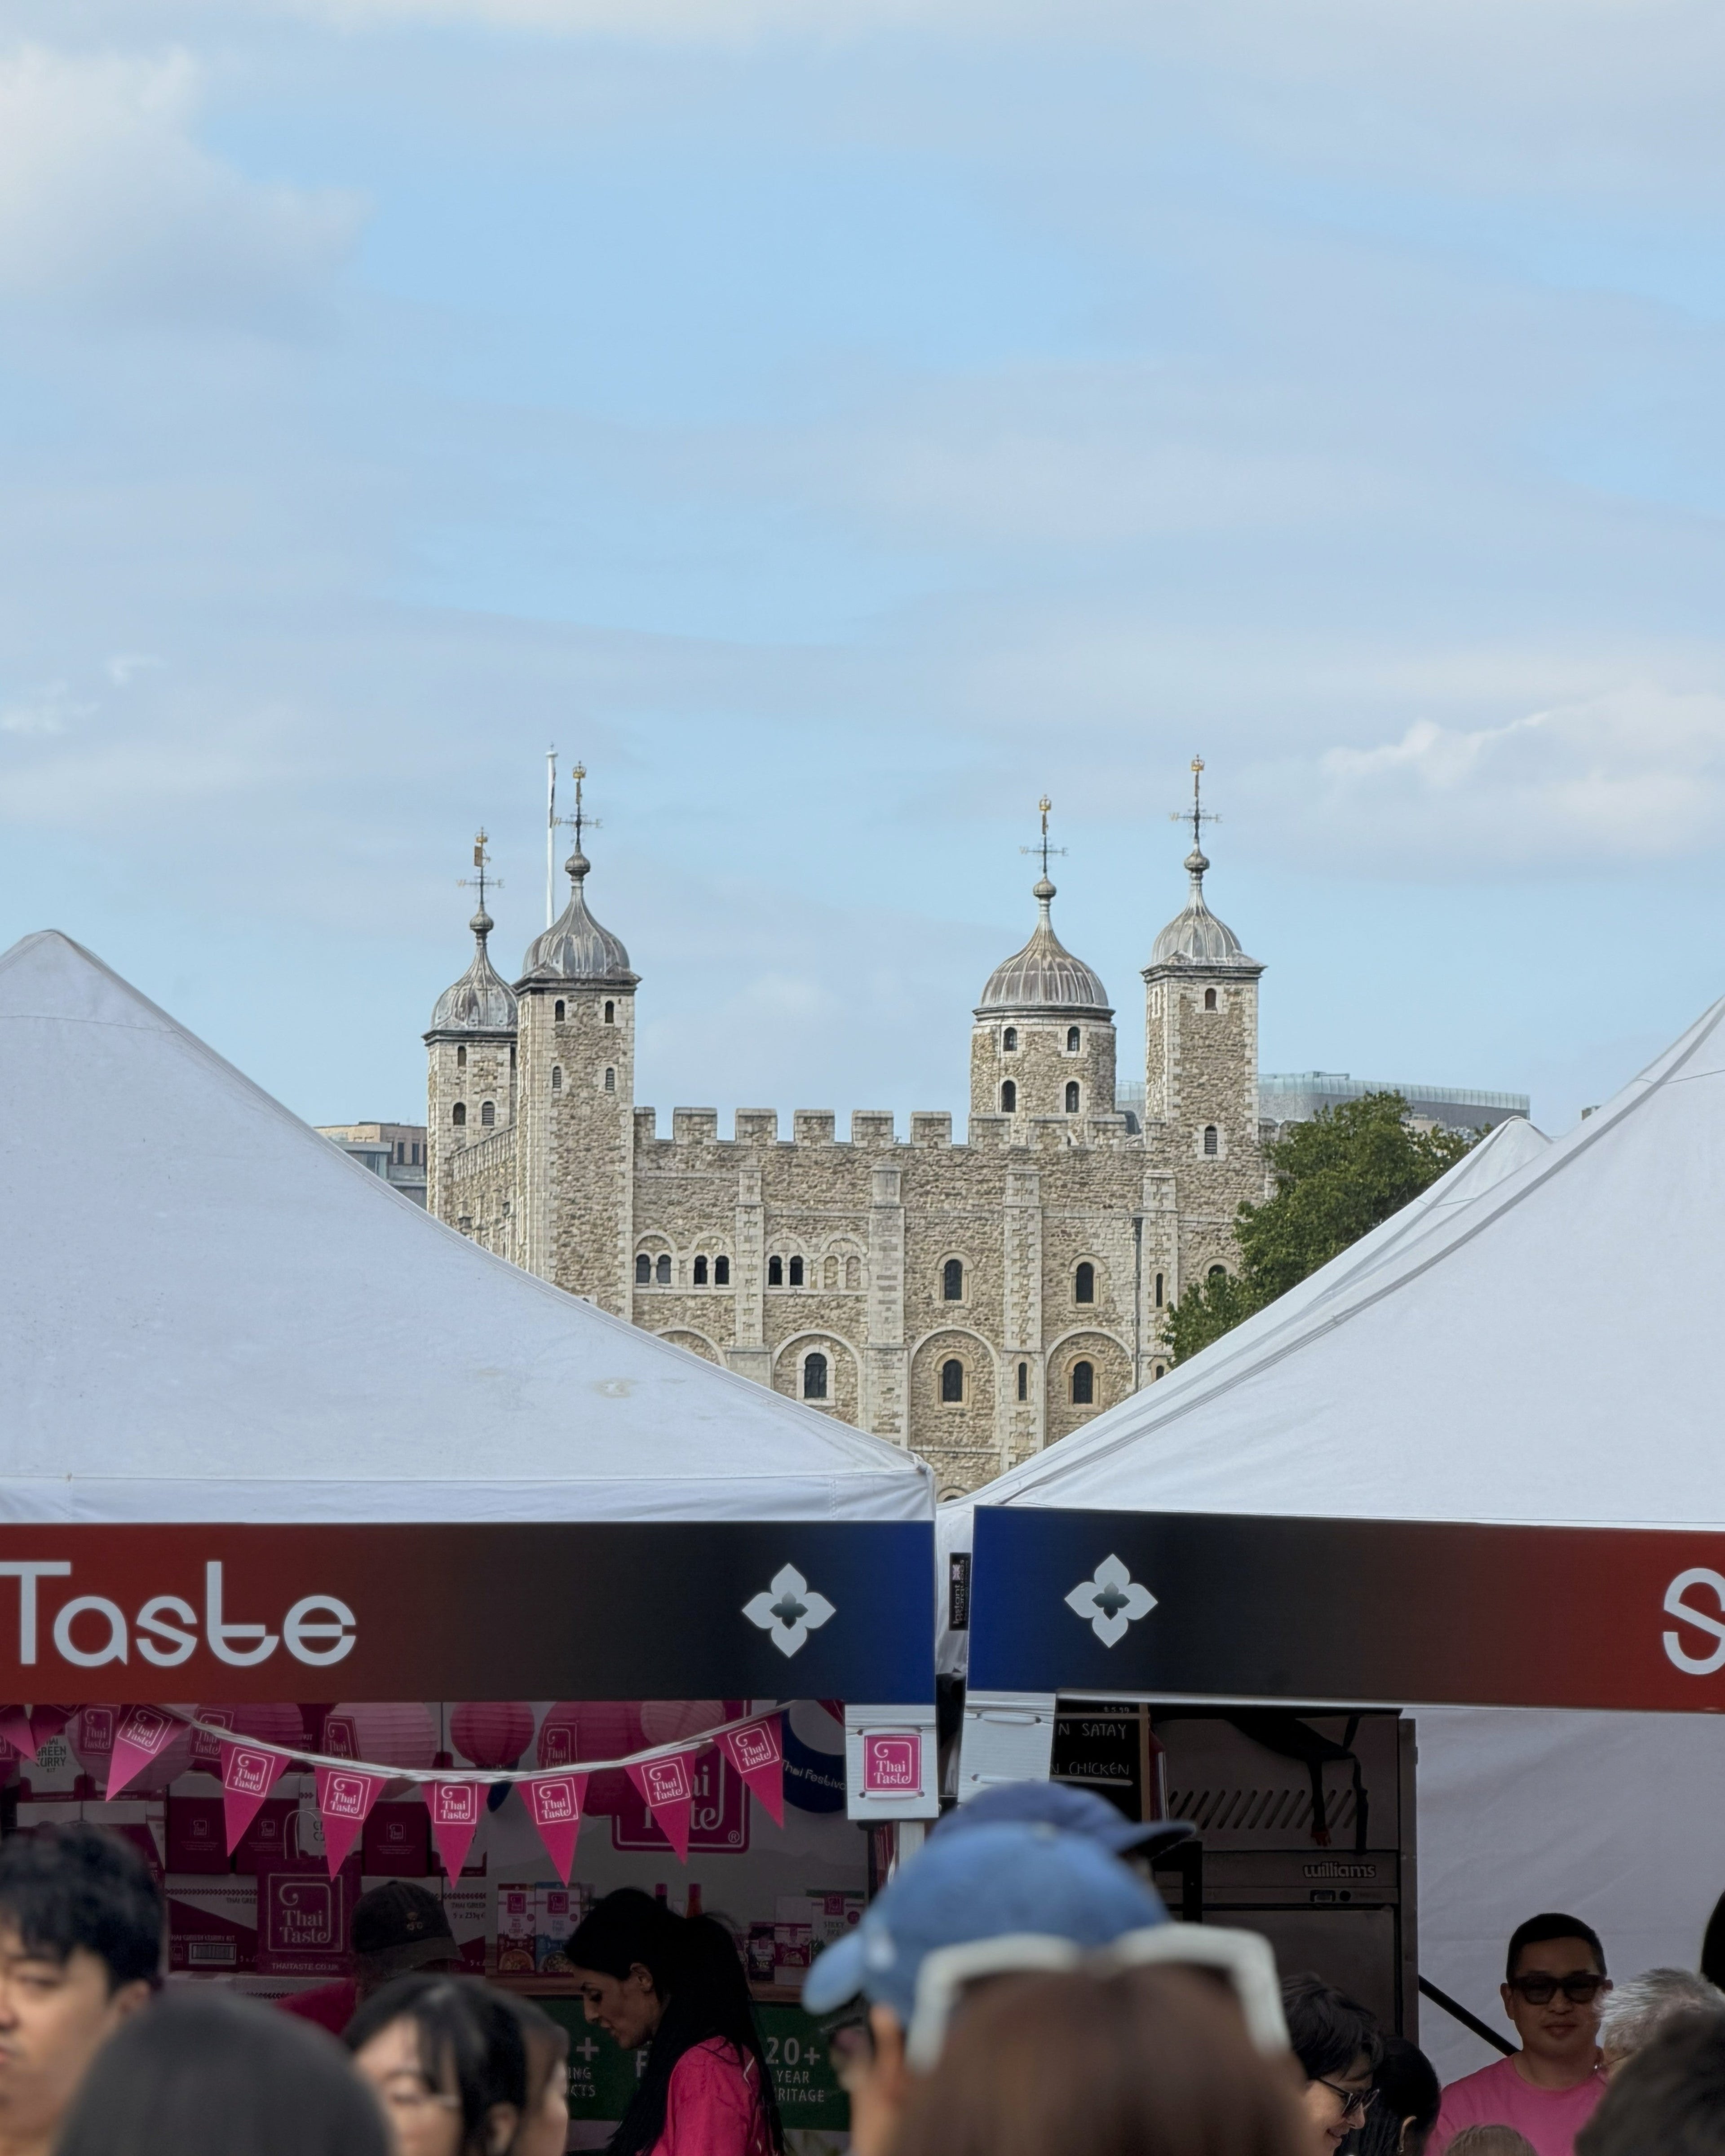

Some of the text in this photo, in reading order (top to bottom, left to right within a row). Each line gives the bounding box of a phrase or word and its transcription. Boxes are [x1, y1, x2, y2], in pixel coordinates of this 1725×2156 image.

[952, 1584, 960, 1624] Instant
[0, 1560, 357, 1667] Taste
[1662, 1567, 1725, 1675] S
[87, 1726, 106, 1740] Thai
[127, 1728, 153, 1747] Taste
[133, 1722, 154, 1738] Thai
[1082, 1723, 1127, 1740] SATAY
[36, 1745, 66, 1757] GREEN
[84, 1738, 110, 1750] Taste
[195, 1741, 221, 1755] Taste
[740, 1743, 765, 1758] Thai
[742, 1752, 772, 1767] Taste
[876, 1760, 906, 1772] Thai
[237, 1767, 260, 1782] Thai
[782, 1759, 803, 1776] Thai
[1069, 1761, 1130, 1776] CHICKEN
[233, 1776, 262, 1791] Taste
[654, 1777, 677, 1791] Thai
[874, 1772, 912, 1785] Taste
[333, 1792, 356, 1805] Thai
[654, 1788, 683, 1801] Taste
[330, 1800, 358, 1814] Taste
[442, 1800, 466, 1810] Thai
[542, 1798, 566, 1809] Thai
[440, 1809, 469, 1820] Taste
[541, 1808, 571, 1819] Taste
[1304, 1861, 1376, 1878] williams
[282, 1910, 323, 1926] Thai
[279, 1926, 330, 1944] Taste
[765, 2037, 820, 2066] 20+
[777, 2069, 809, 2085] YEAR
[774, 2087, 824, 2103] RITAGE
